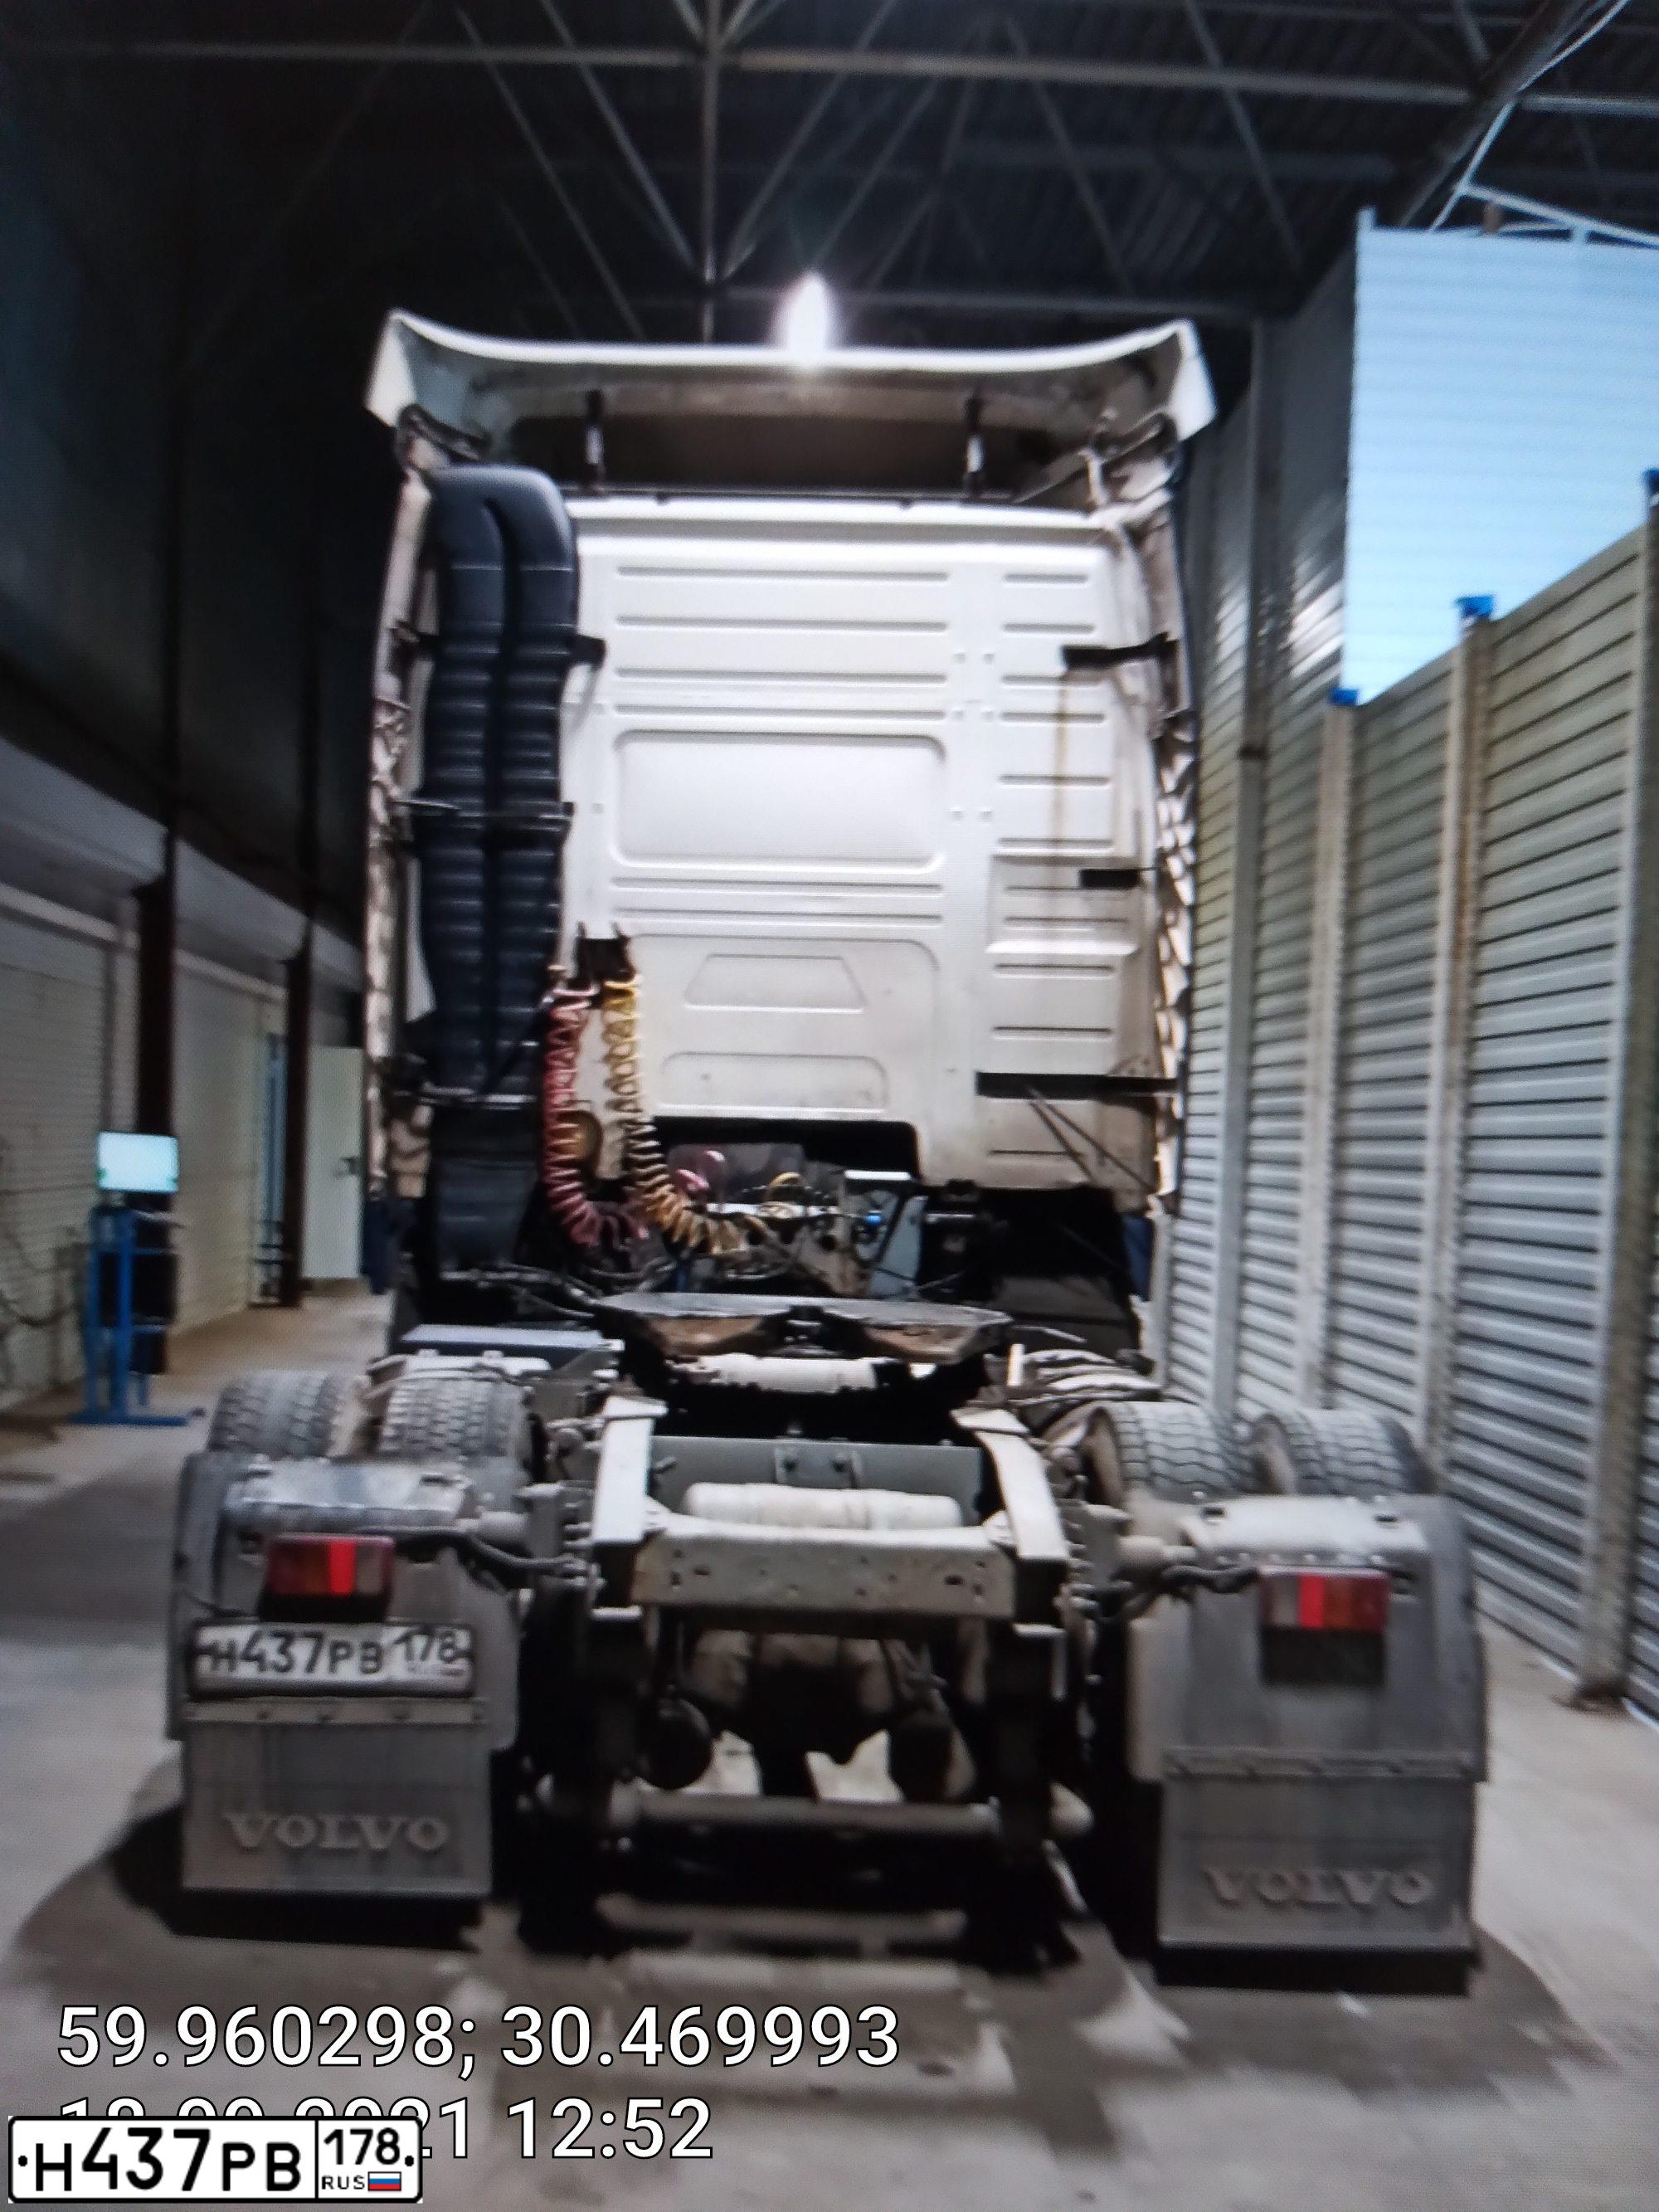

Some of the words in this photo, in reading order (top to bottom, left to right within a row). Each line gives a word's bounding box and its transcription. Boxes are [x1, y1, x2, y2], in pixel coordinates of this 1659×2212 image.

[393, 1625, 460, 1664] 178
[224, 1812, 450, 1851] VOLVO
[1203, 1867, 1437, 1908] VOLVO
